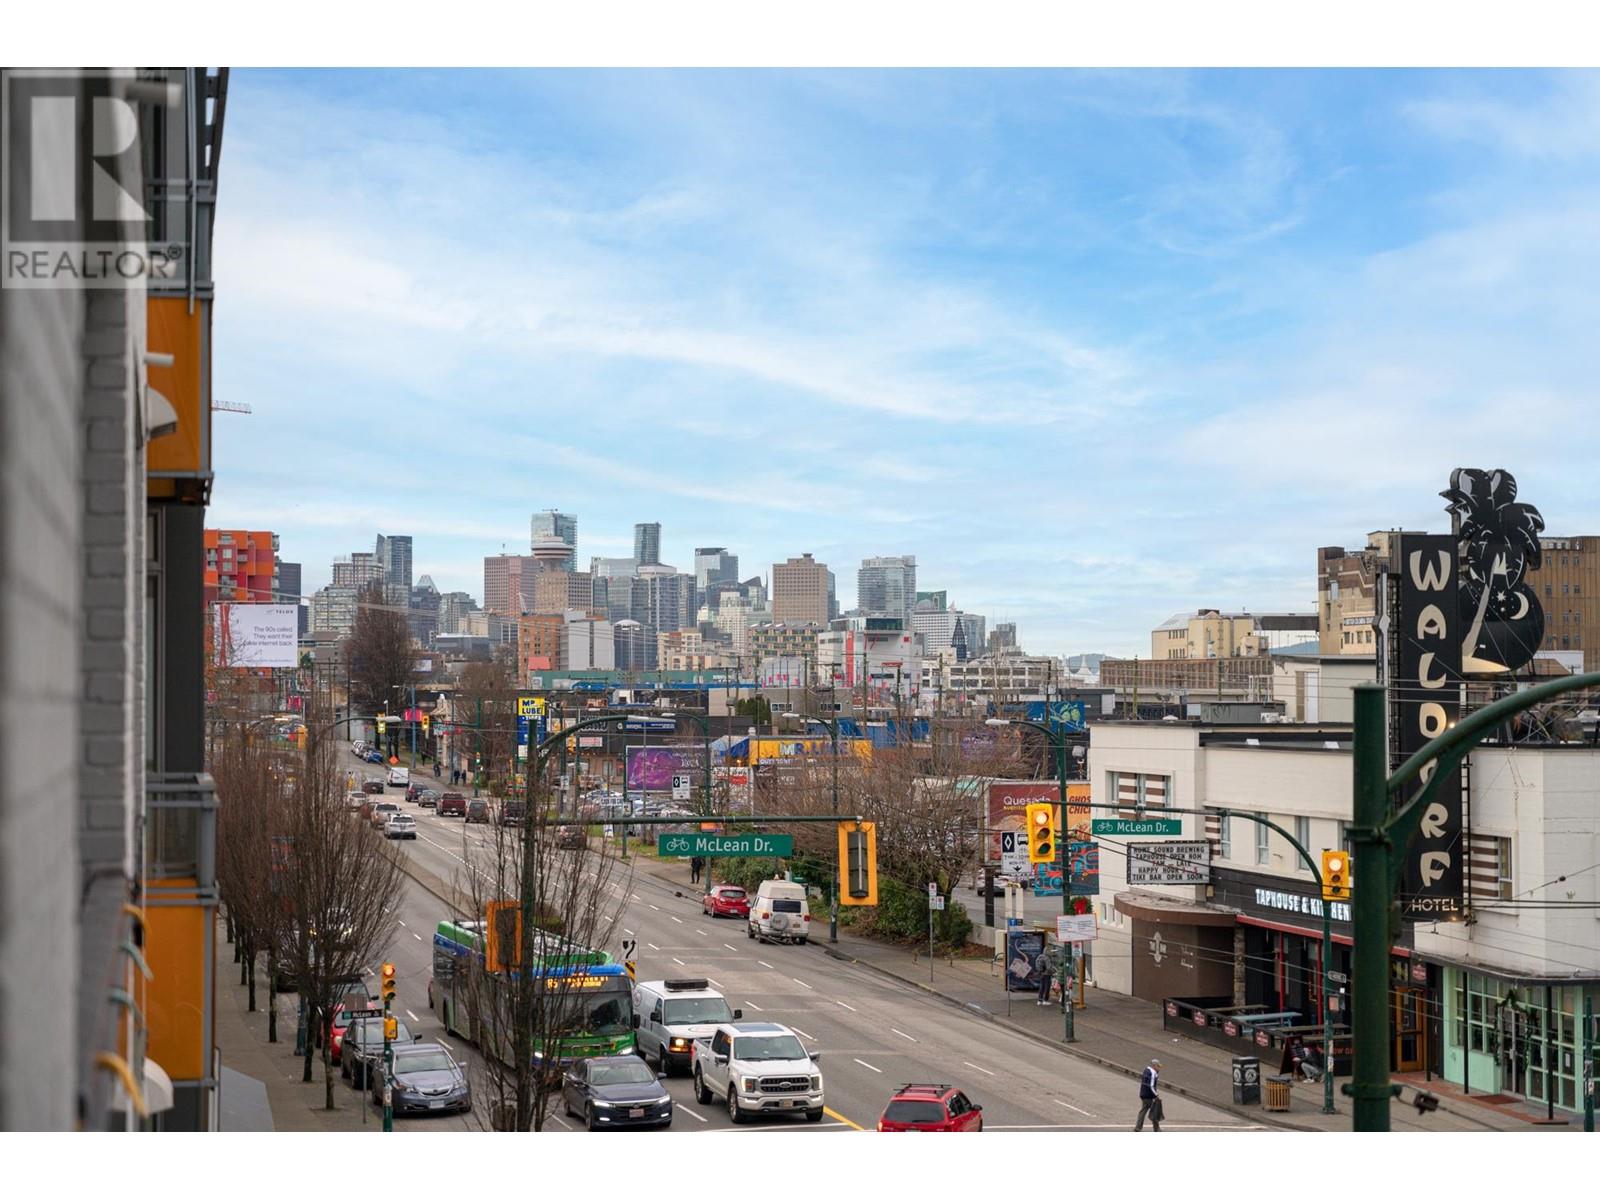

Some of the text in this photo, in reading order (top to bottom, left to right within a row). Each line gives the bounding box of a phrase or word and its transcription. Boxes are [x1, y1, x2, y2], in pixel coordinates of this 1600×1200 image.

[1117, 822, 1169, 832] McLean Dr.
[696, 838, 773, 852] McLean Dr.
[1255, 888, 1301, 912] TAPHOUSE
[1412, 898, 1458, 912] HOTEL
